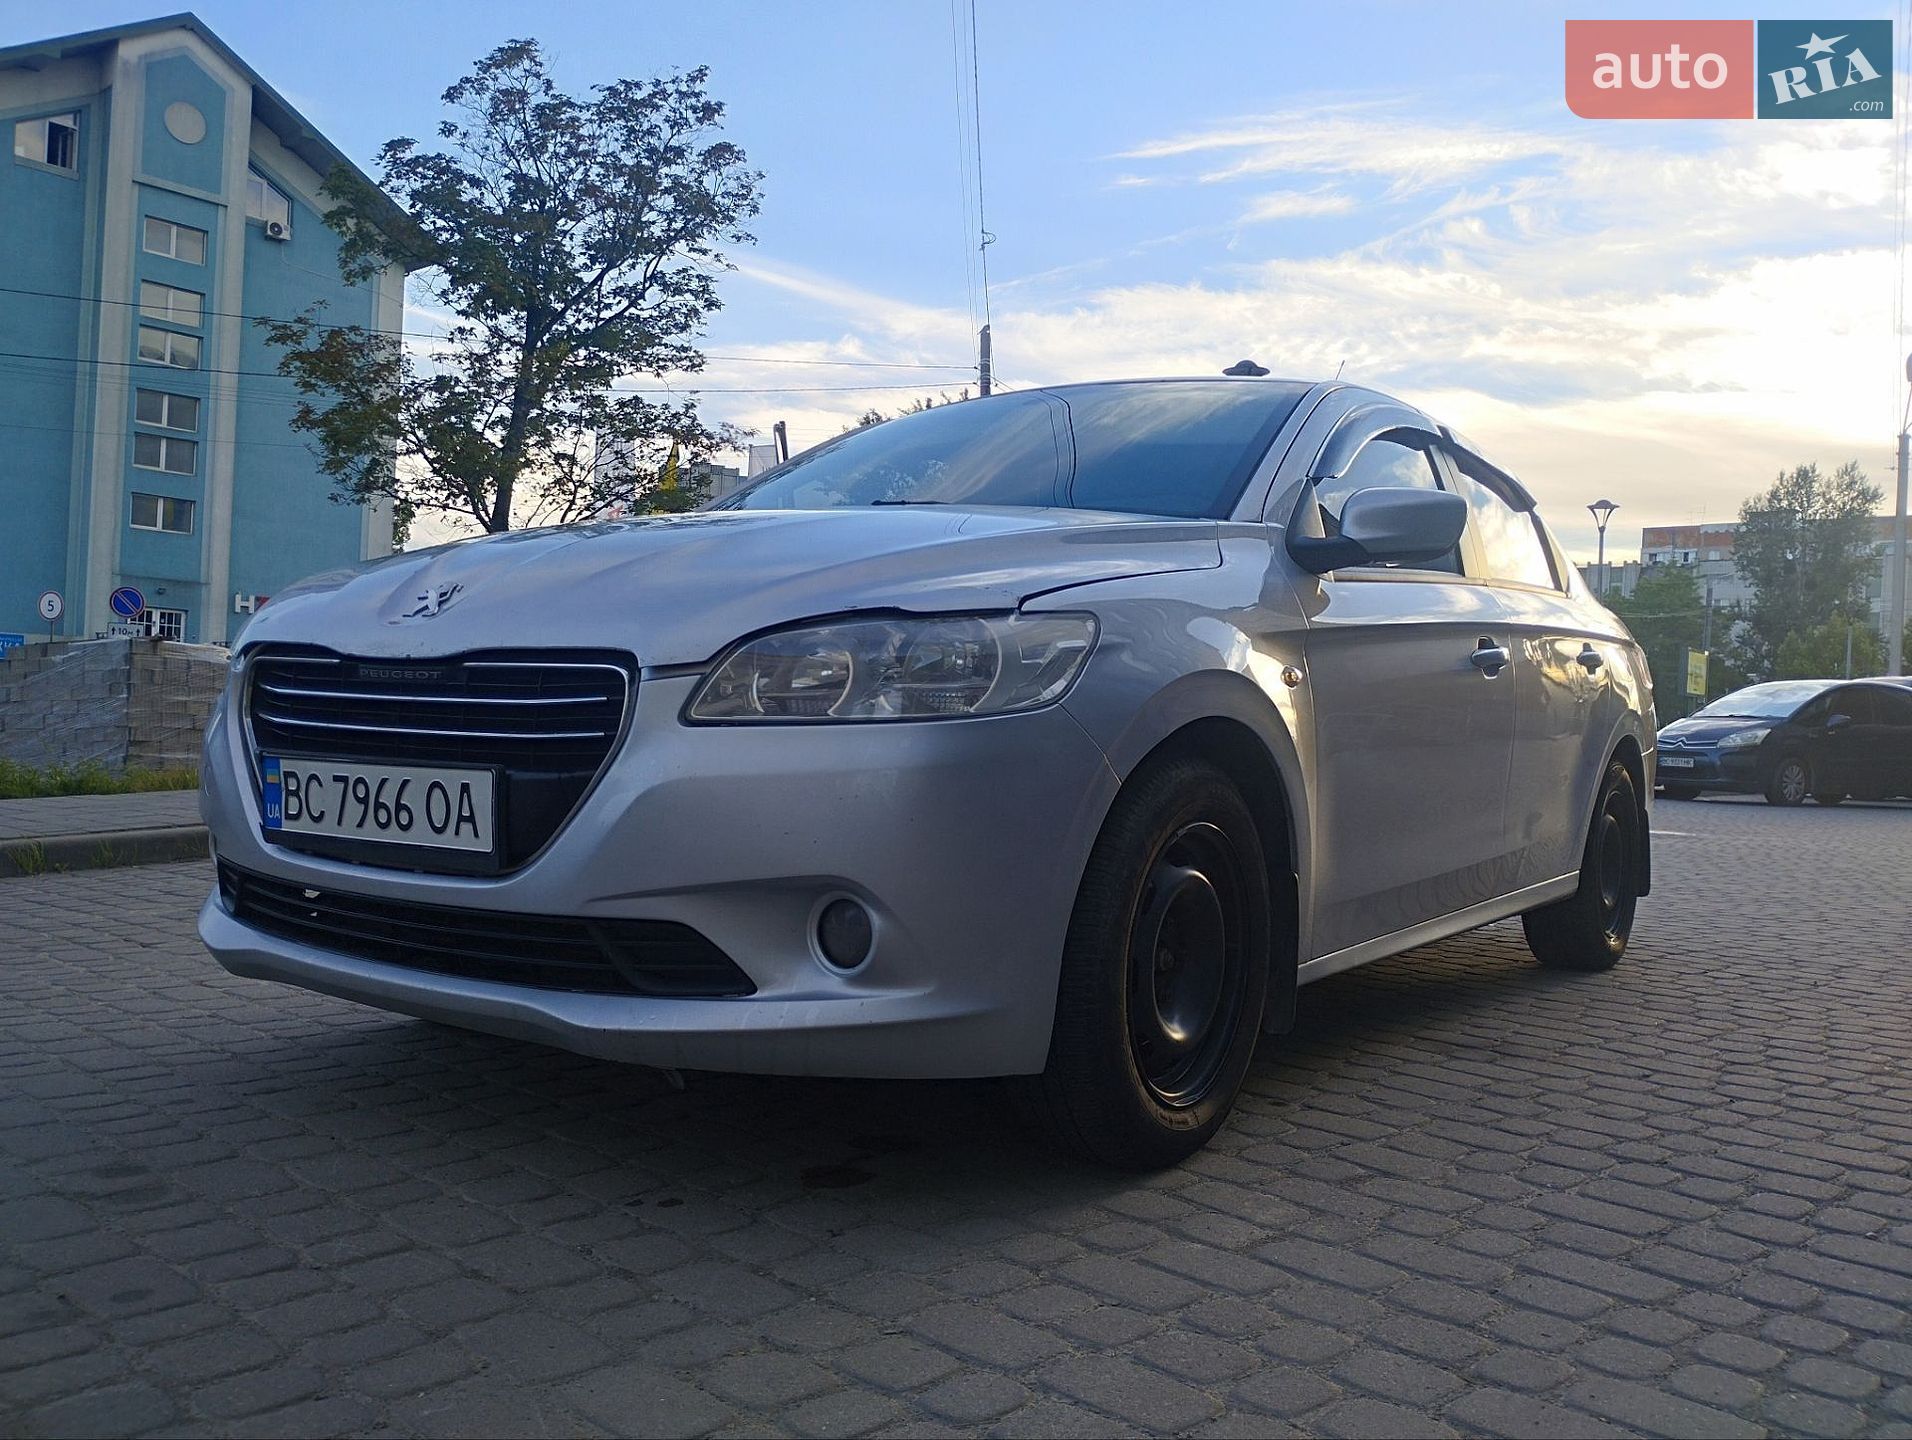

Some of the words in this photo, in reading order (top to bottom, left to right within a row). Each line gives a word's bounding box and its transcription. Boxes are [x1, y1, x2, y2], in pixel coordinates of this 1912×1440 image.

[47, 600, 55, 612] 5
[359, 668, 442, 680] PEUGEOT
[284, 771, 325, 824] BC
[333, 775, 414, 832] 7966
[267, 803, 280, 819] UA
